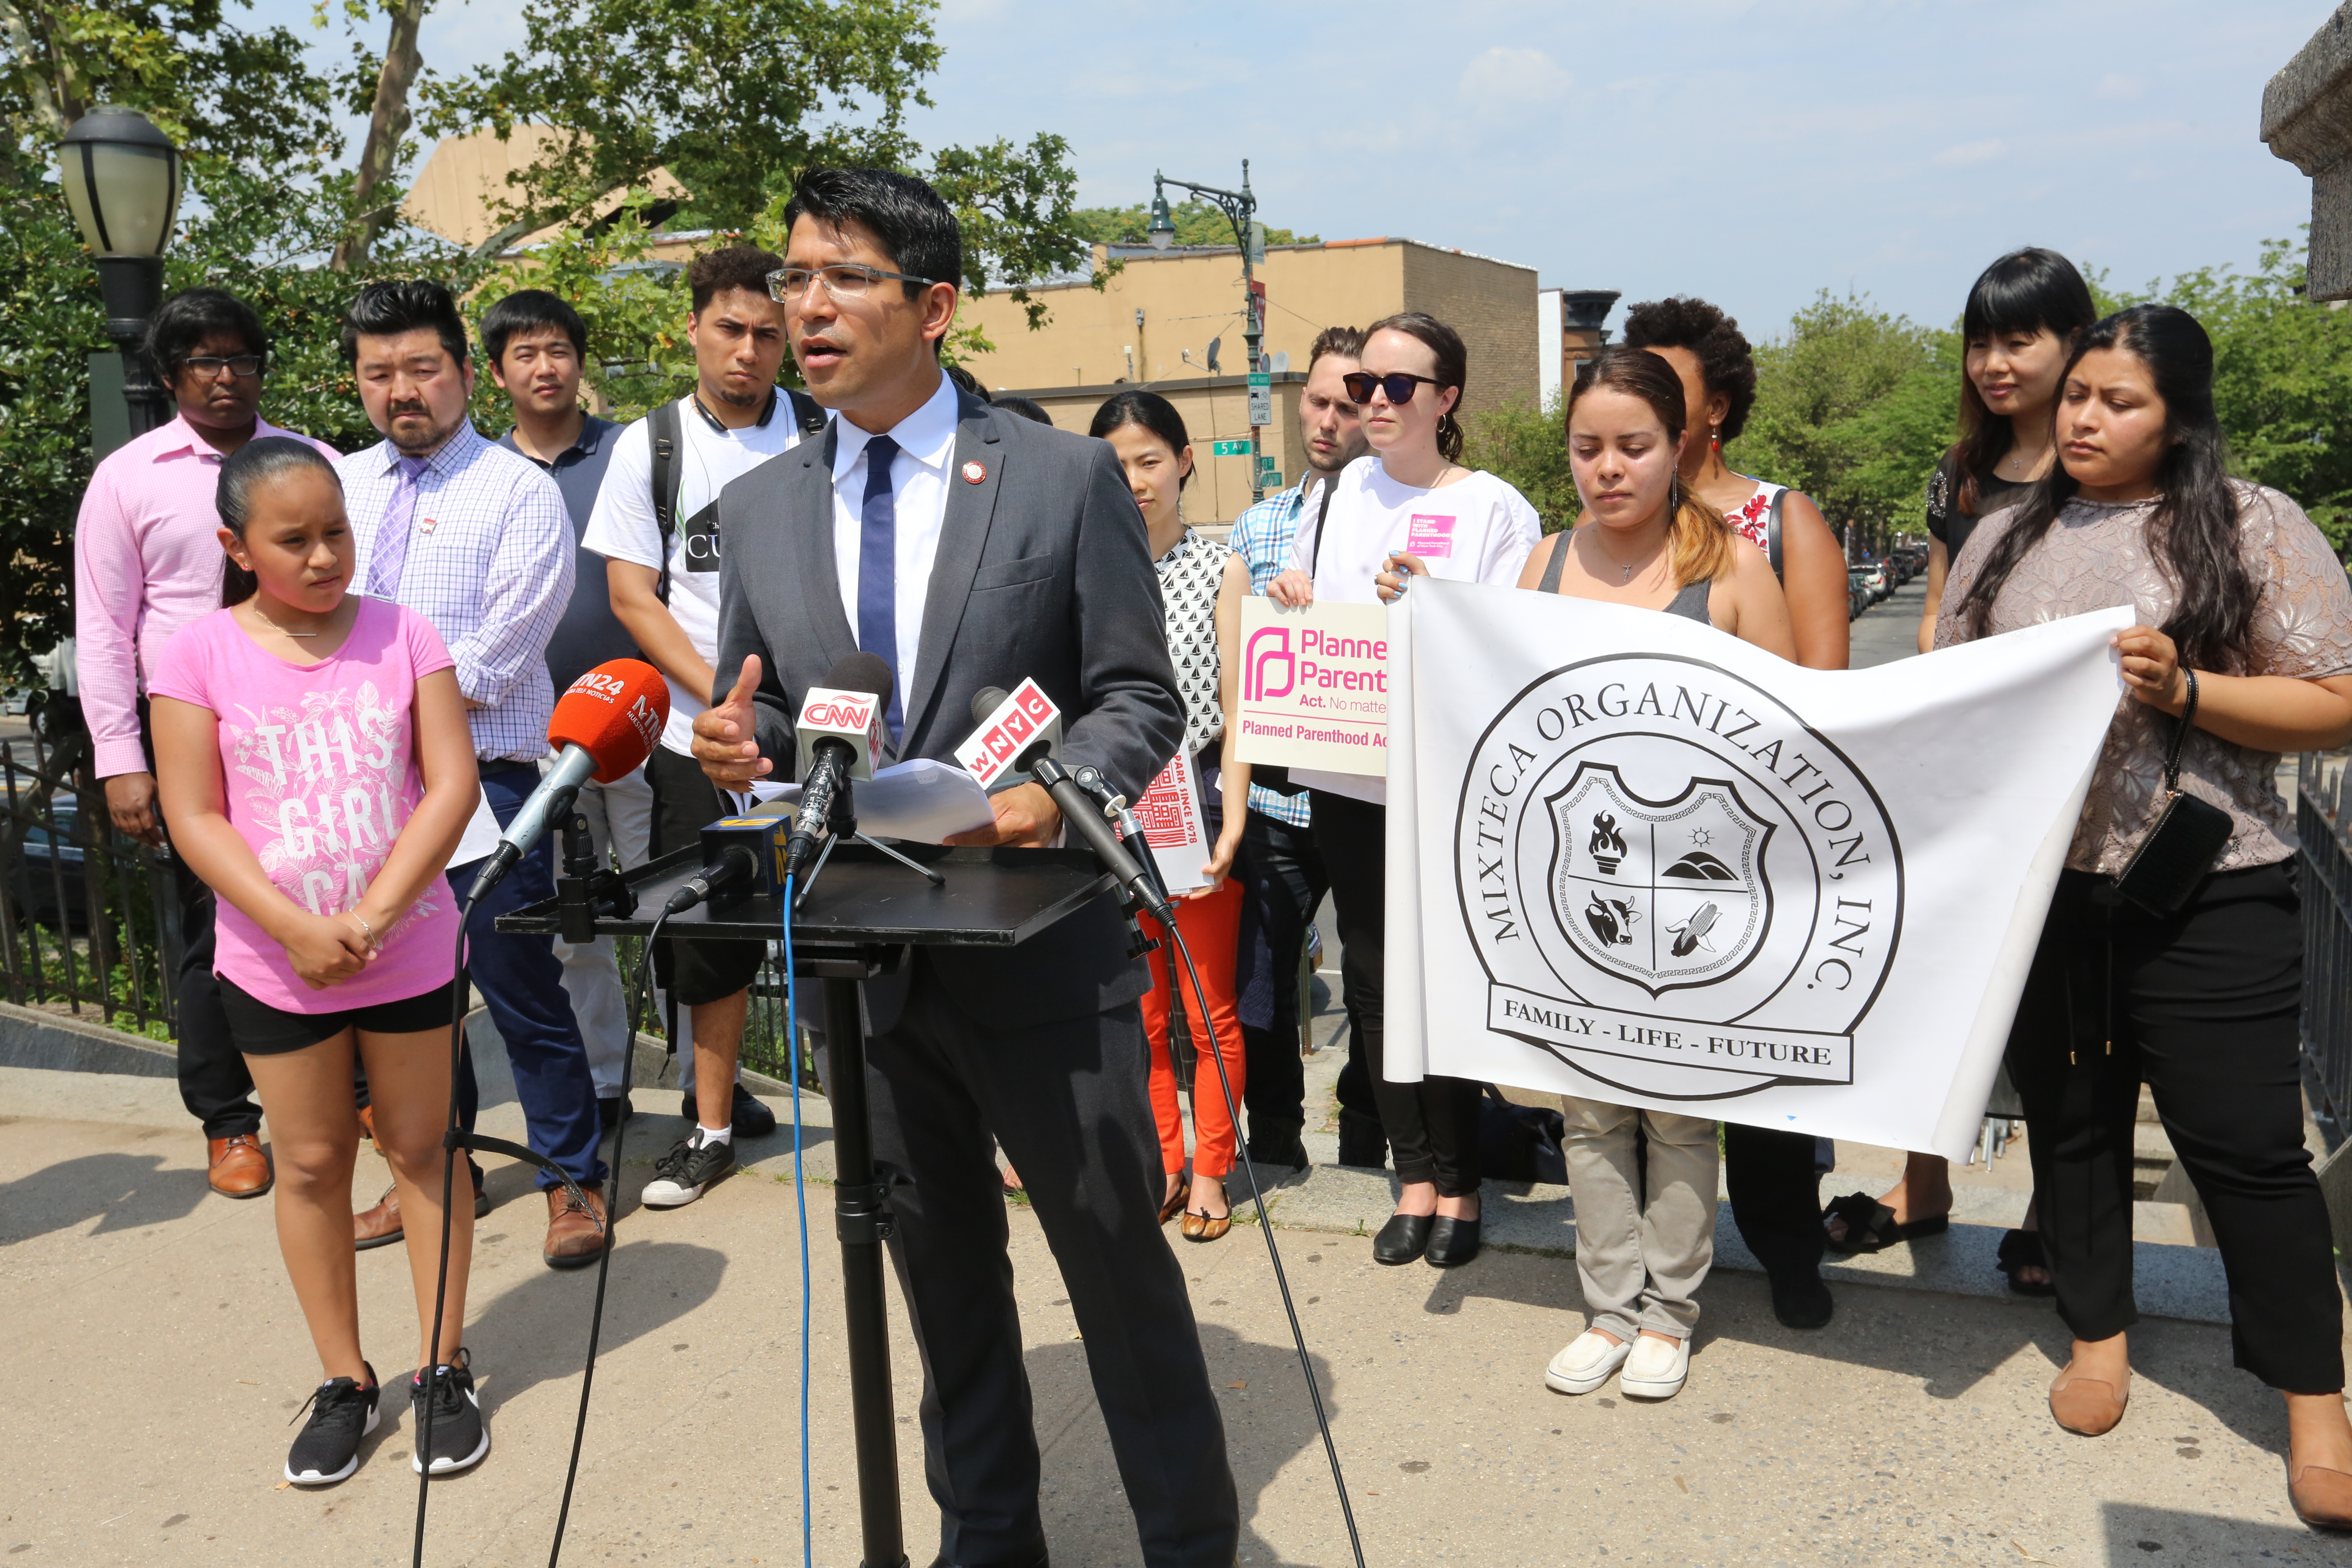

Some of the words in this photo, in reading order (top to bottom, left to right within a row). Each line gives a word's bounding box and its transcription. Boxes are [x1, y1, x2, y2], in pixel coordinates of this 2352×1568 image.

[1221, 443, 1228, 454] 5
[1232, 442, 1243, 450] AV
[586, 689, 615, 704] NOTICIAS
[1299, 694, 1326, 708] Act.
[1330, 697, 1347, 710] No
[626, 710, 645, 736] NUESTRA
[804, 703, 870, 729] CNN
[969, 698, 1044, 773] WNYC
[1243, 720, 1292, 739] Planned
[1296, 725, 1368, 746] Parenthood
[255, 707, 392, 786] THIS
[1174, 755, 1186, 784] PARK
[1180, 788, 1193, 817] SINCE
[279, 782, 403, 860] GIRL
[717, 818, 779, 826] 12
[1186, 820, 1197, 844] 1978
[1477, 743, 1537, 945] MIXTECA
[1537, 682, 1871, 880] ORGANIZATION,
[1807, 896, 1872, 991] INC.
[1504, 999, 1596, 1035] FAMILY
[1617, 1024, 1682, 1049] LIFE
[1707, 1036, 1832, 1065] FUTURE
